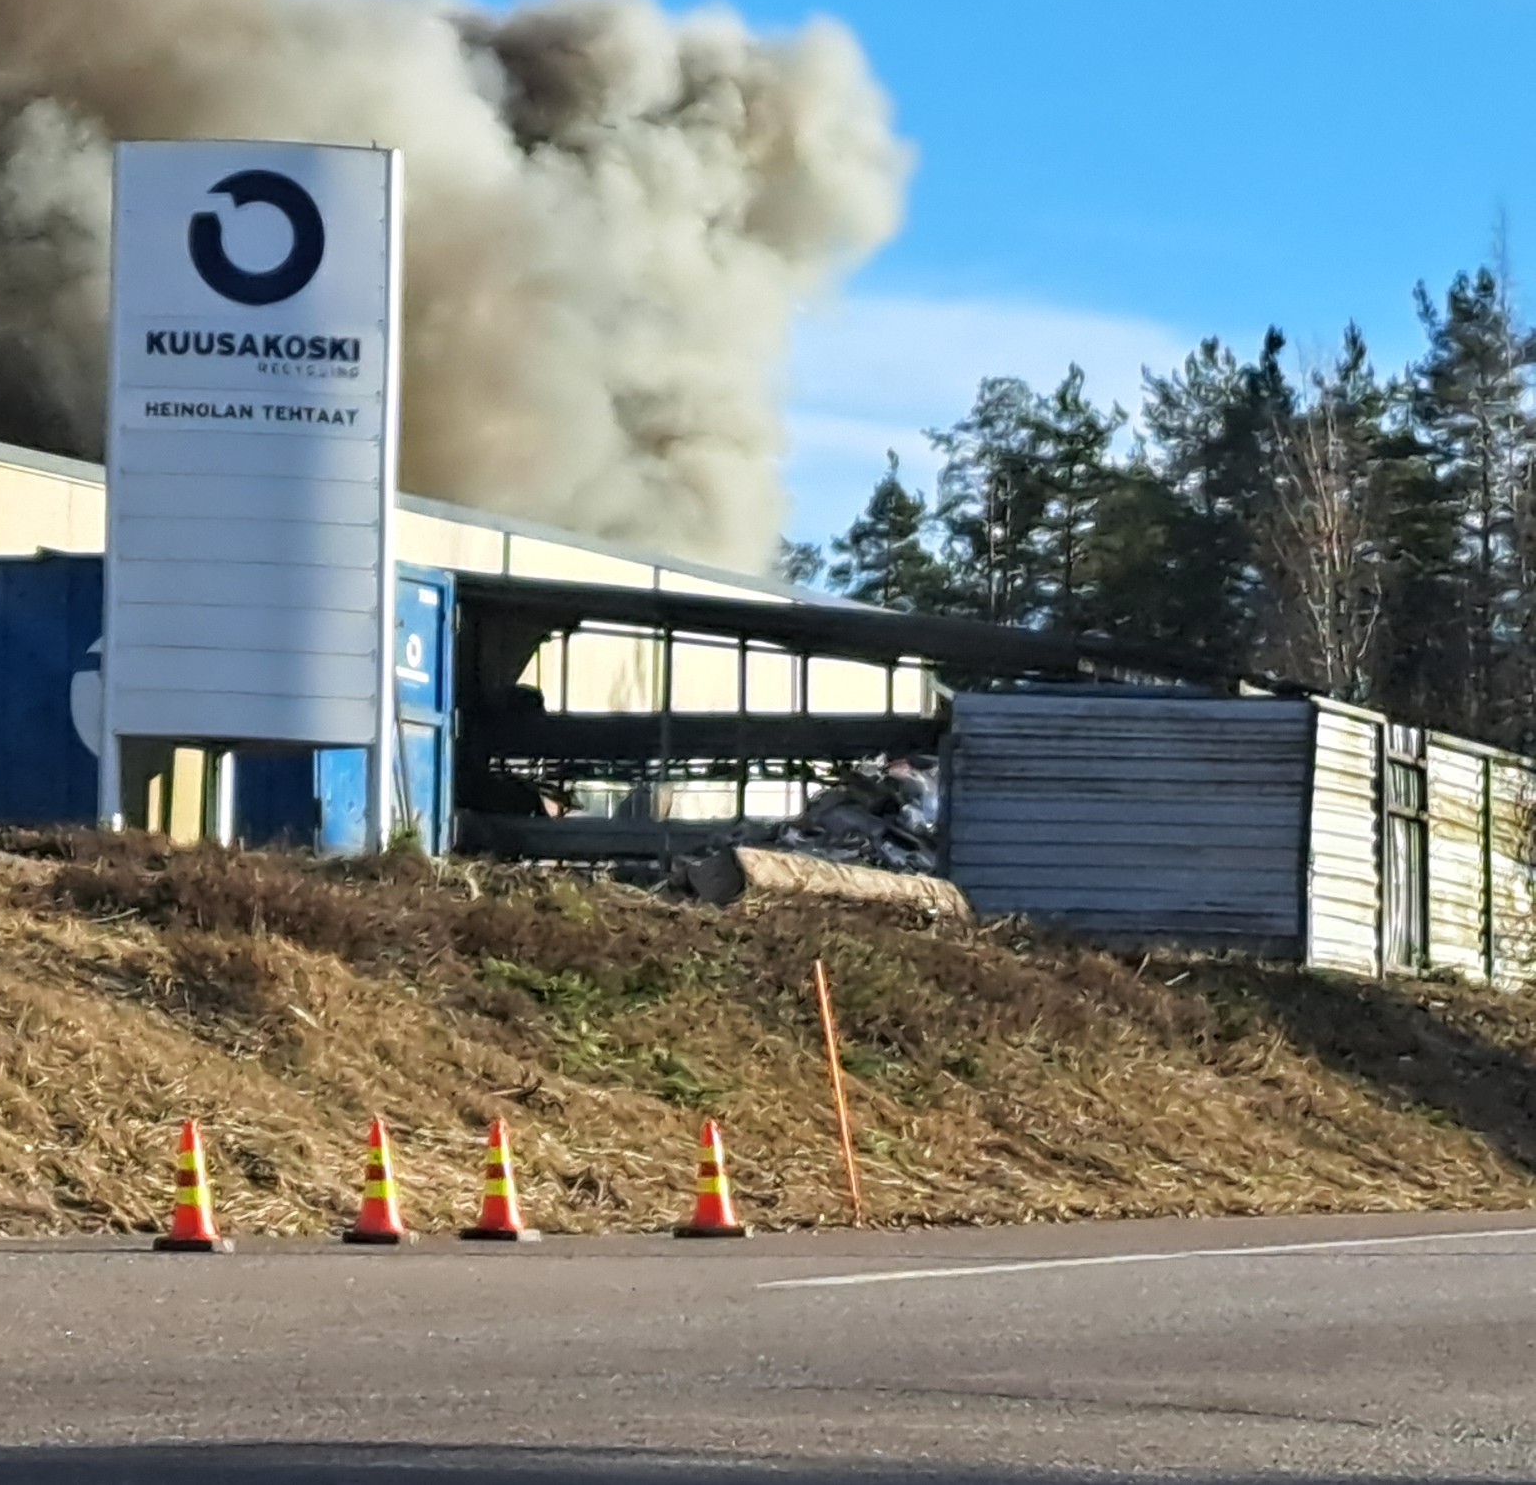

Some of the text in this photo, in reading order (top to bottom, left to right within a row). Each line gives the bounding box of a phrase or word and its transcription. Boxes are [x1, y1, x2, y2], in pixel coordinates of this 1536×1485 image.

[146, 330, 361, 362] KUUSAKOSKI
[145, 402, 359, 426] HEINOLAN TEHTAAT
